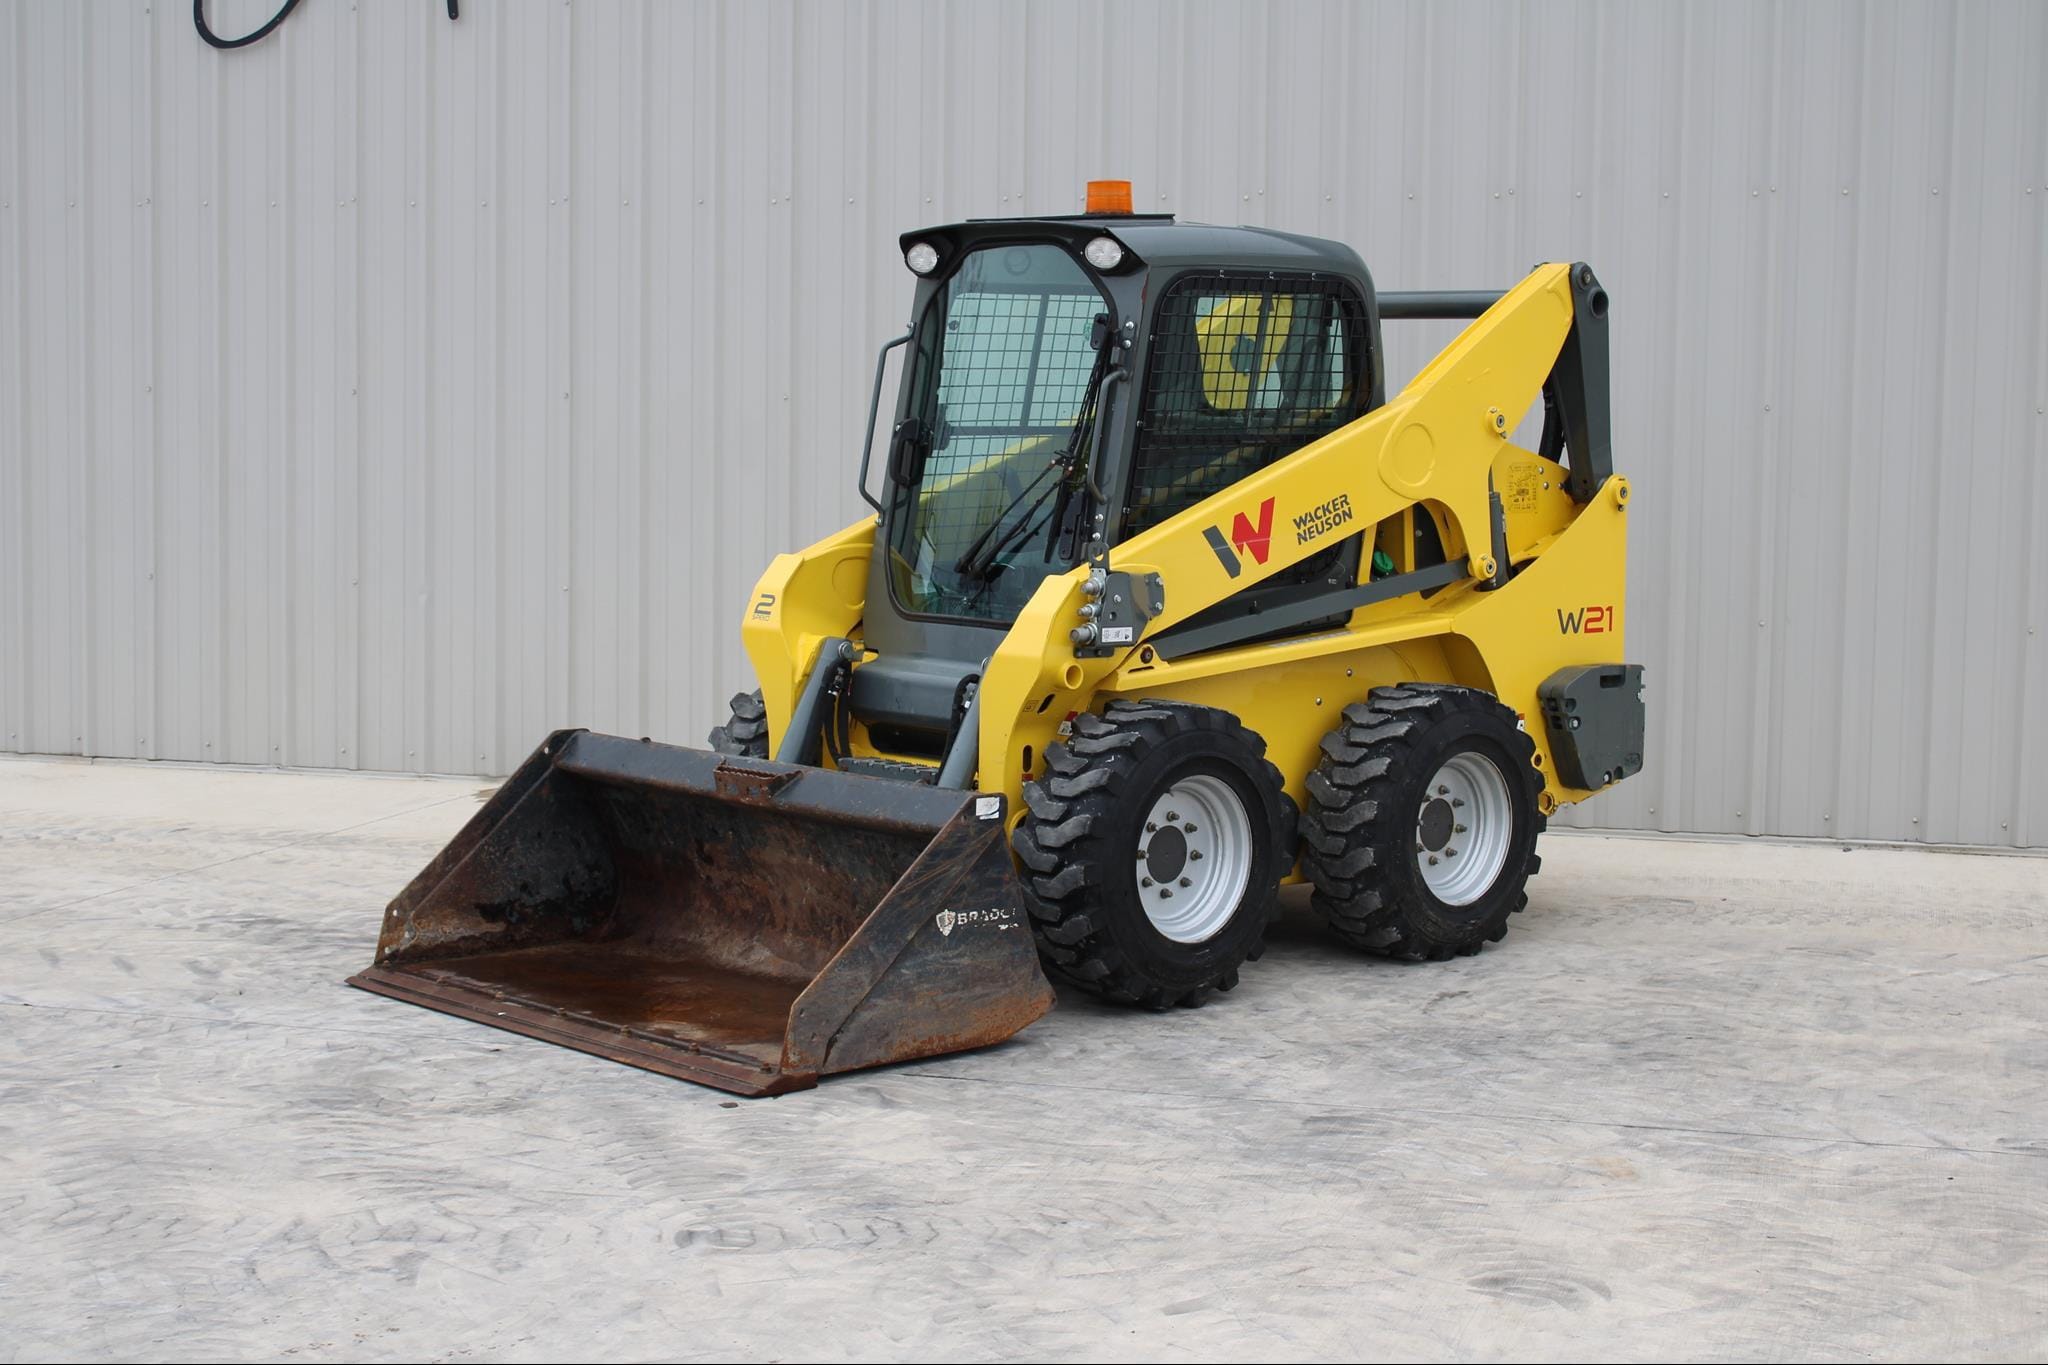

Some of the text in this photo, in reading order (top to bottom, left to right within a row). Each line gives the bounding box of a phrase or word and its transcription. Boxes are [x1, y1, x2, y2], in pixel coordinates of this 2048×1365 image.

[1293, 494, 1350, 530] WACKER
[1297, 506, 1353, 545] NEUSON
[754, 593, 776, 616] 2
[1557, 606, 1613, 634] W21
